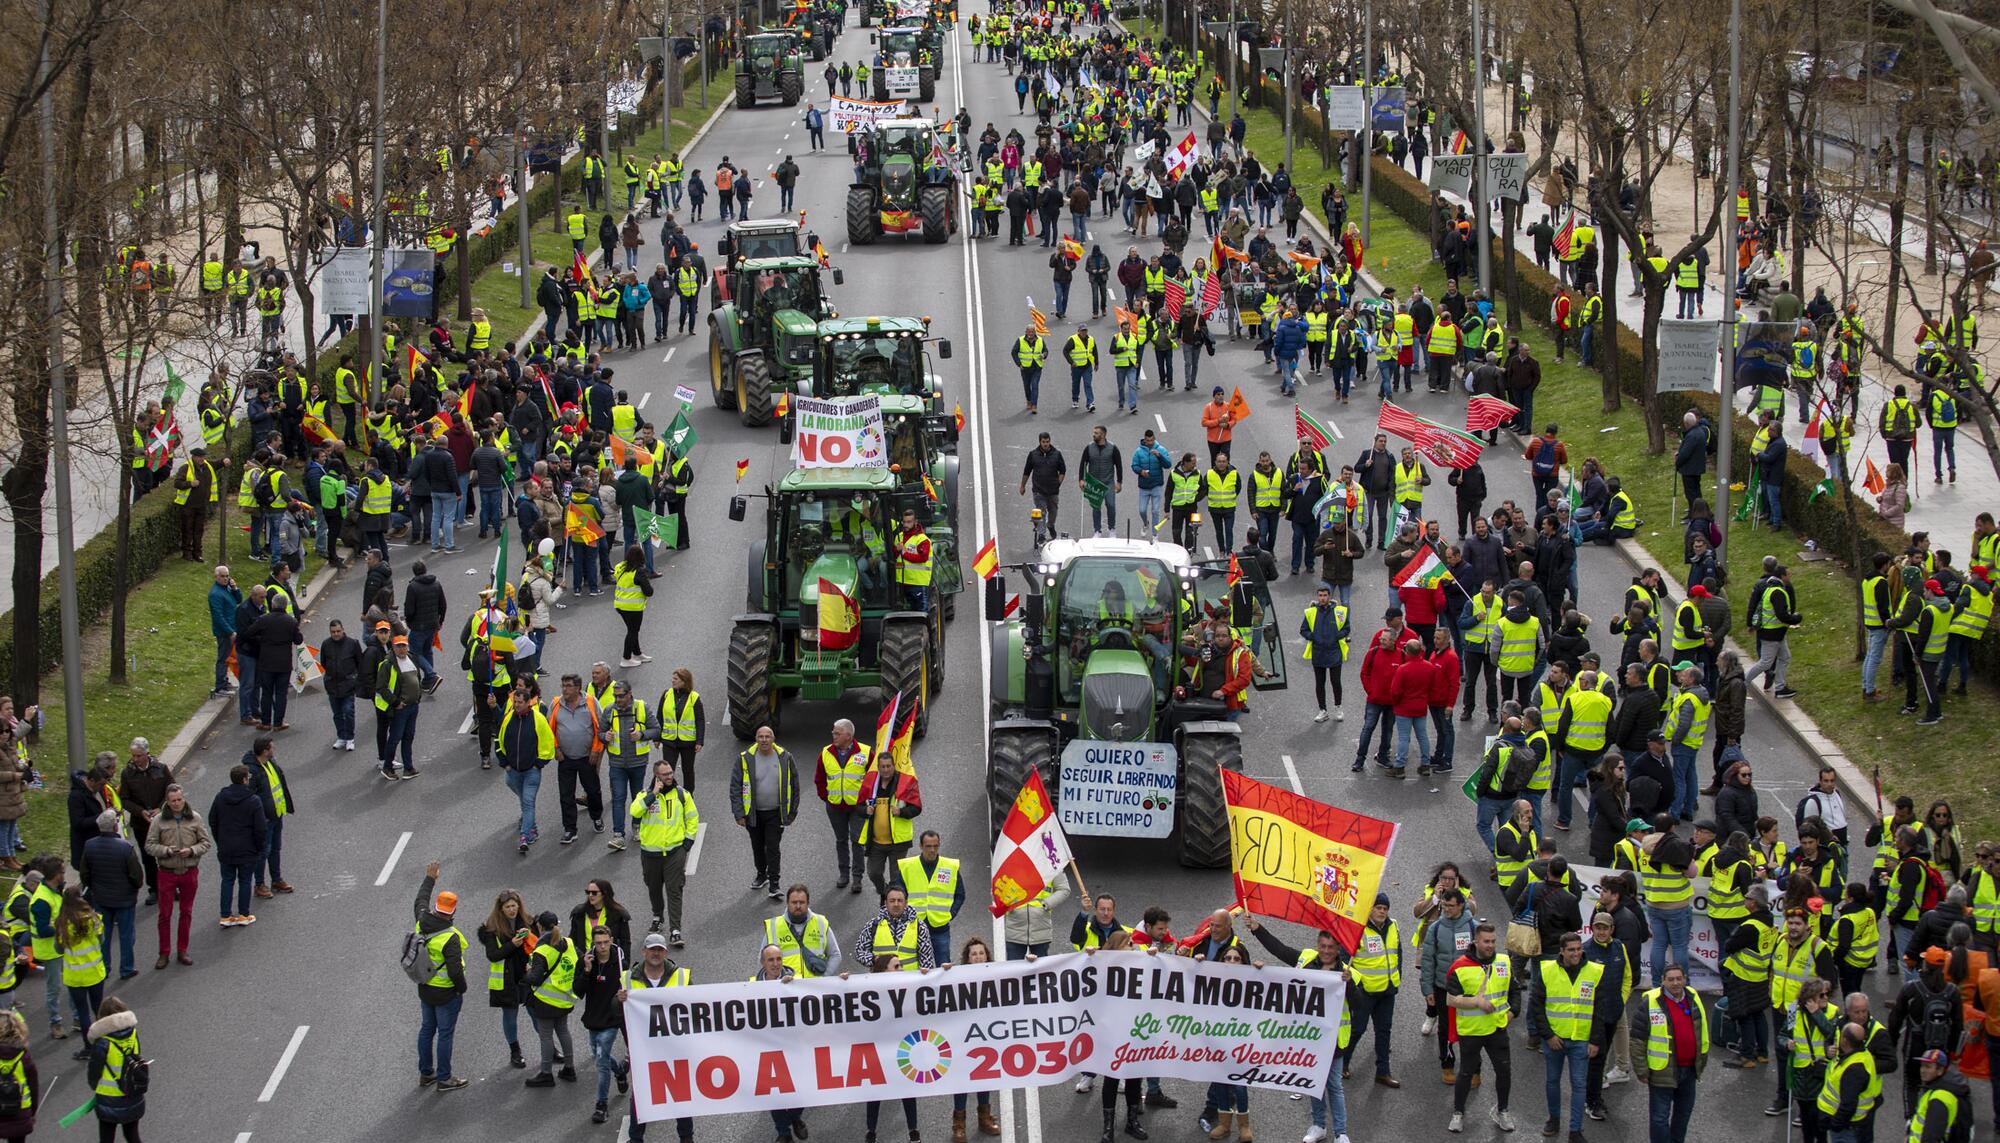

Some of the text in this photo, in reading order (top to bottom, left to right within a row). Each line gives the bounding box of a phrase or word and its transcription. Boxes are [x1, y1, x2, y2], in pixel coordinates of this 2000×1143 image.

[1434, 158, 1472, 169] MAD
[1446, 166, 1469, 178] RID
[1489, 157, 1519, 170] CUL
[1492, 167, 1512, 179] TU
[1499, 178, 1519, 191] RA
[839, 405, 844, 416] Y
[845, 399, 874, 415] GANADEROS
[802, 414, 865, 431] LA MORAÑA
[799, 432, 852, 463] NO
[1085, 748, 1145, 766] QUIERO
[1062, 767, 1176, 789] SEGUIR LABRANDO
[1064, 787, 1140, 806] MI FUTURO
[779, 935, 792, 943] NO
[648, 966, 1326, 1038] AGRICULTORES Y GANADEROS DE LA MORAÑA
[963, 1009, 1095, 1043] AGENDA
[1130, 1012, 1322, 1041] La Moraña Unida
[966, 1032, 1094, 1081] 2030
[1110, 1040, 1318, 1071] Jamás sera Vencida
[647, 1042, 887, 1105] NO A LA
[1227, 1065, 1316, 1089] Ávila
